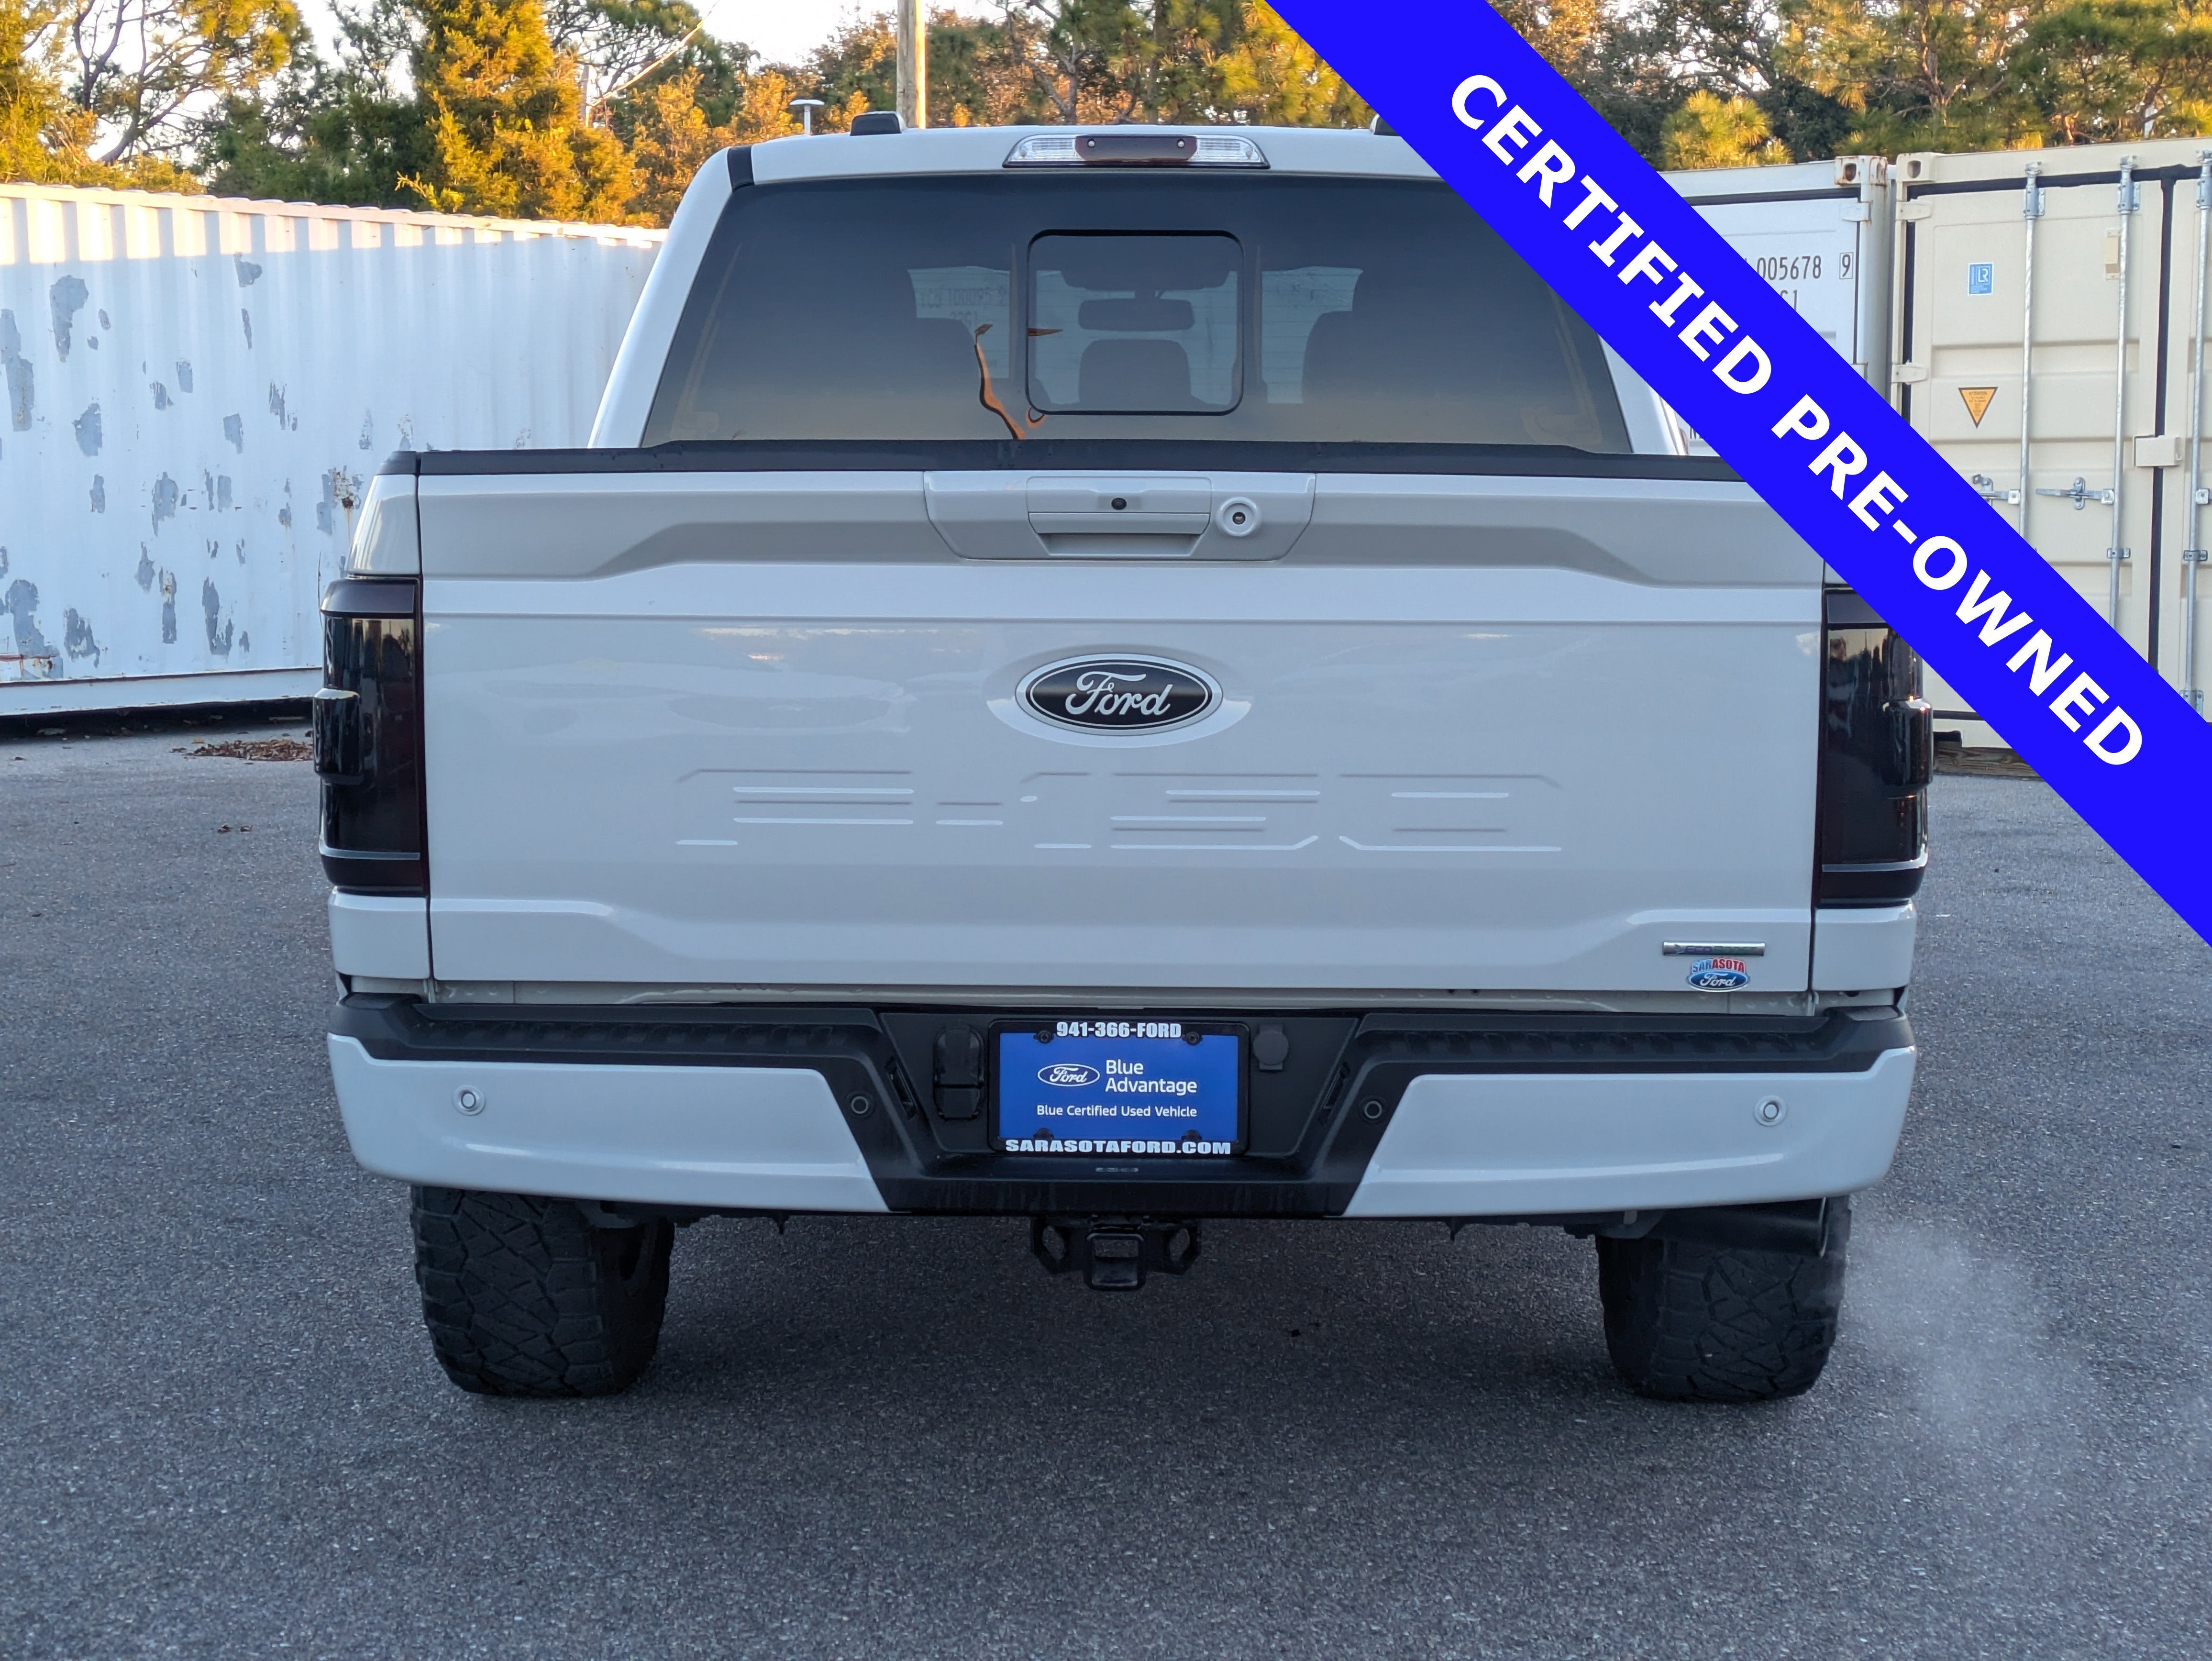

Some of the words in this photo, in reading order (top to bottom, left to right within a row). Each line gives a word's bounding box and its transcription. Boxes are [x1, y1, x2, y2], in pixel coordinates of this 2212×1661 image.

[1757, 255, 1822, 280] 005678
[1842, 254, 1851, 277] 9
[1065, 671, 1173, 715] Ford
[1692, 958, 1745, 973] SARASOTA
[1700, 973, 1736, 986] Ford
[1056, 1021, 1182, 1038] 941-366-FORD
[1049, 1066, 1088, 1083] Ford
[1106, 1059, 1144, 1075] Blue
[1105, 1077, 1197, 1096] Advantage
[1037, 1104, 1063, 1116] Blue
[1067, 1105, 1117, 1116] Certified
[1121, 1106, 1151, 1117] Used
[1154, 1106, 1197, 1117] Vehicle
[1006, 1140, 1231, 1154] SARASOTAFORD.COM
